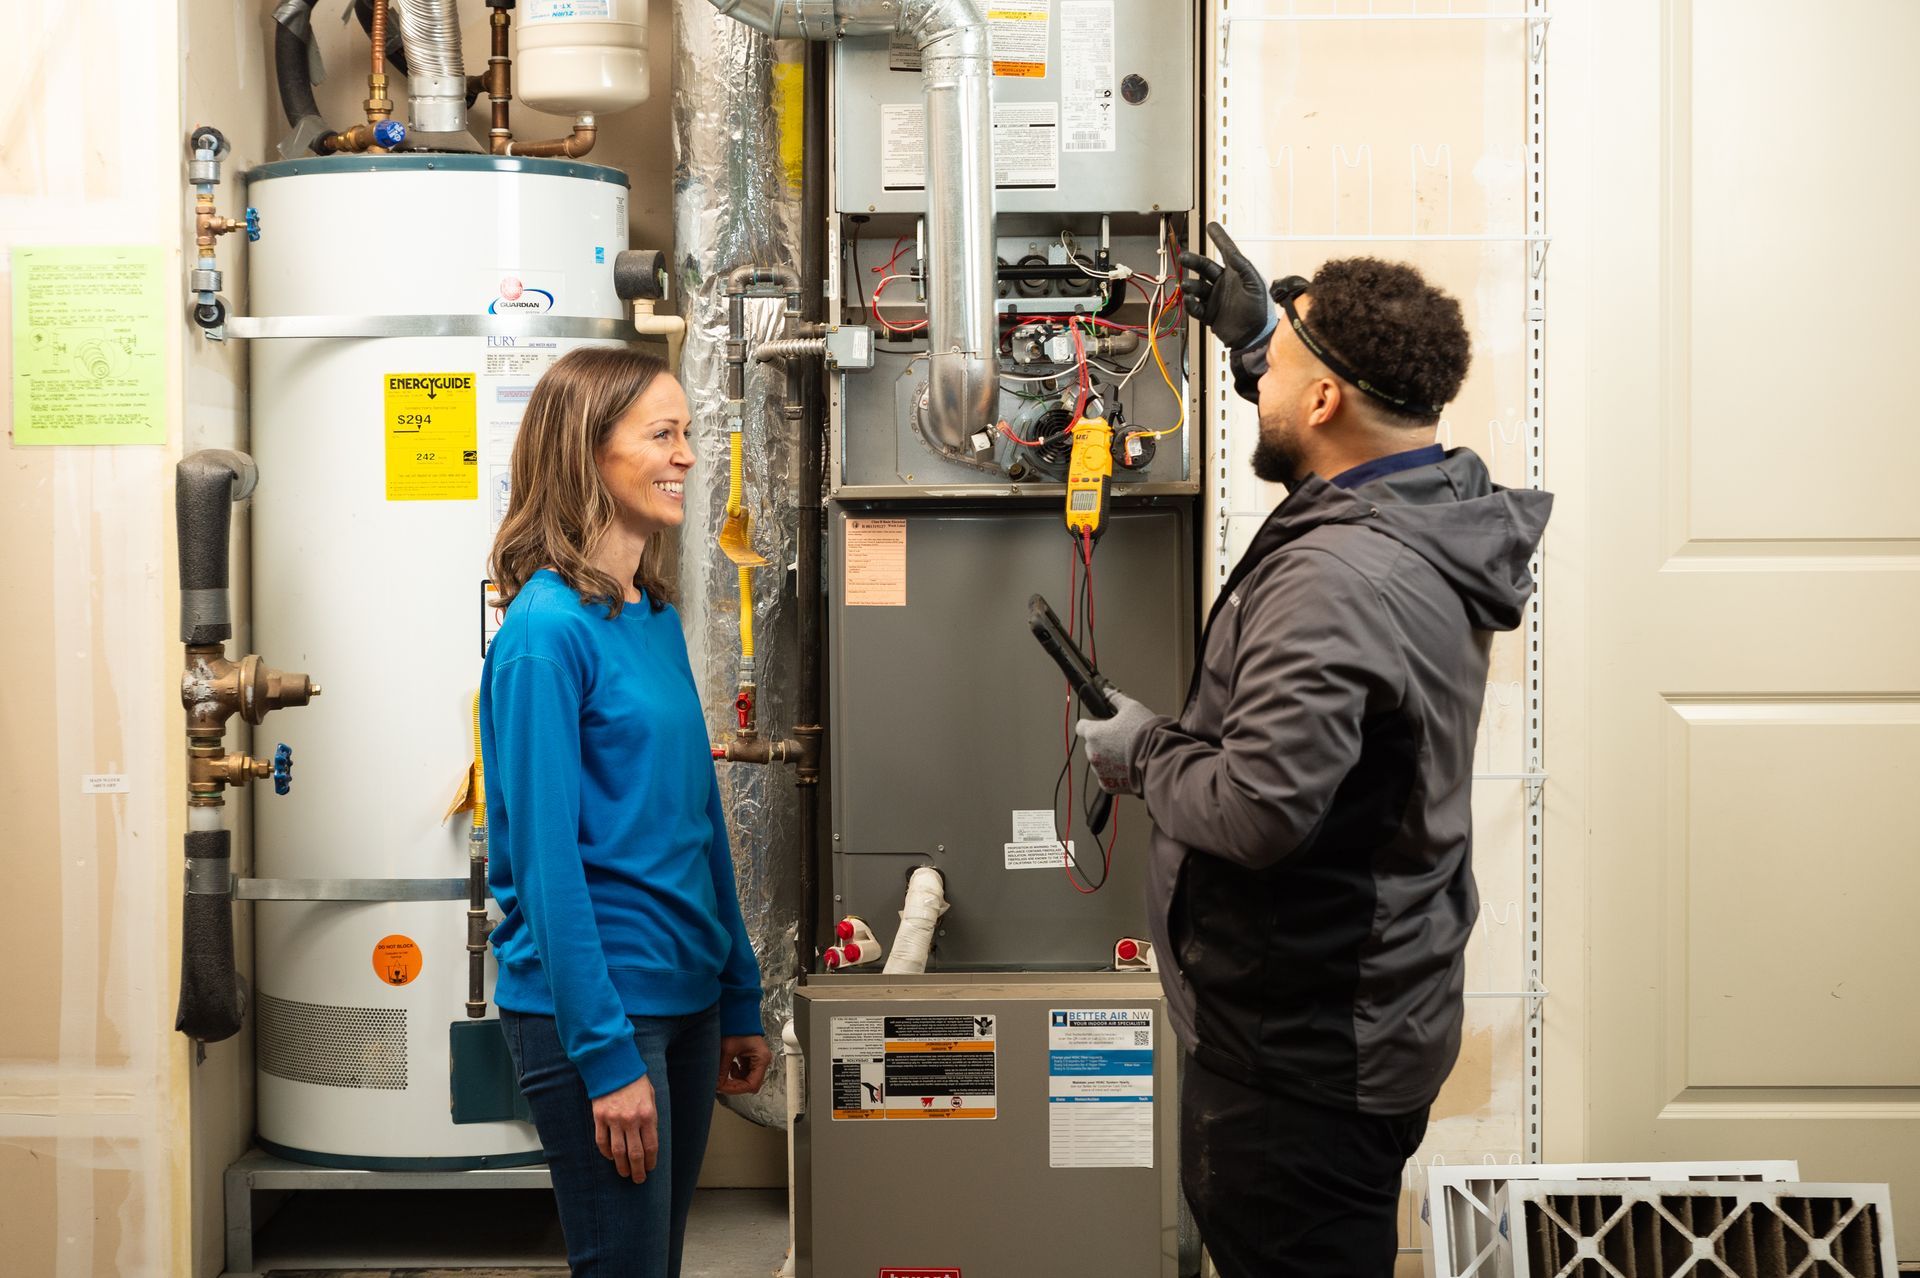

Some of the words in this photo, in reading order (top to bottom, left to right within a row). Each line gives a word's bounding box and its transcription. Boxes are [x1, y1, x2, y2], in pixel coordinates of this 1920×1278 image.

[487, 336, 517, 347] FURY
[389, 377, 471, 390] ENERGYGUIDE
[416, 452, 435, 461] 242
[1069, 1012, 1106, 1020] BETTER
[1110, 1012, 1128, 1020] AIR
[1132, 1012, 1150, 1020] NW
